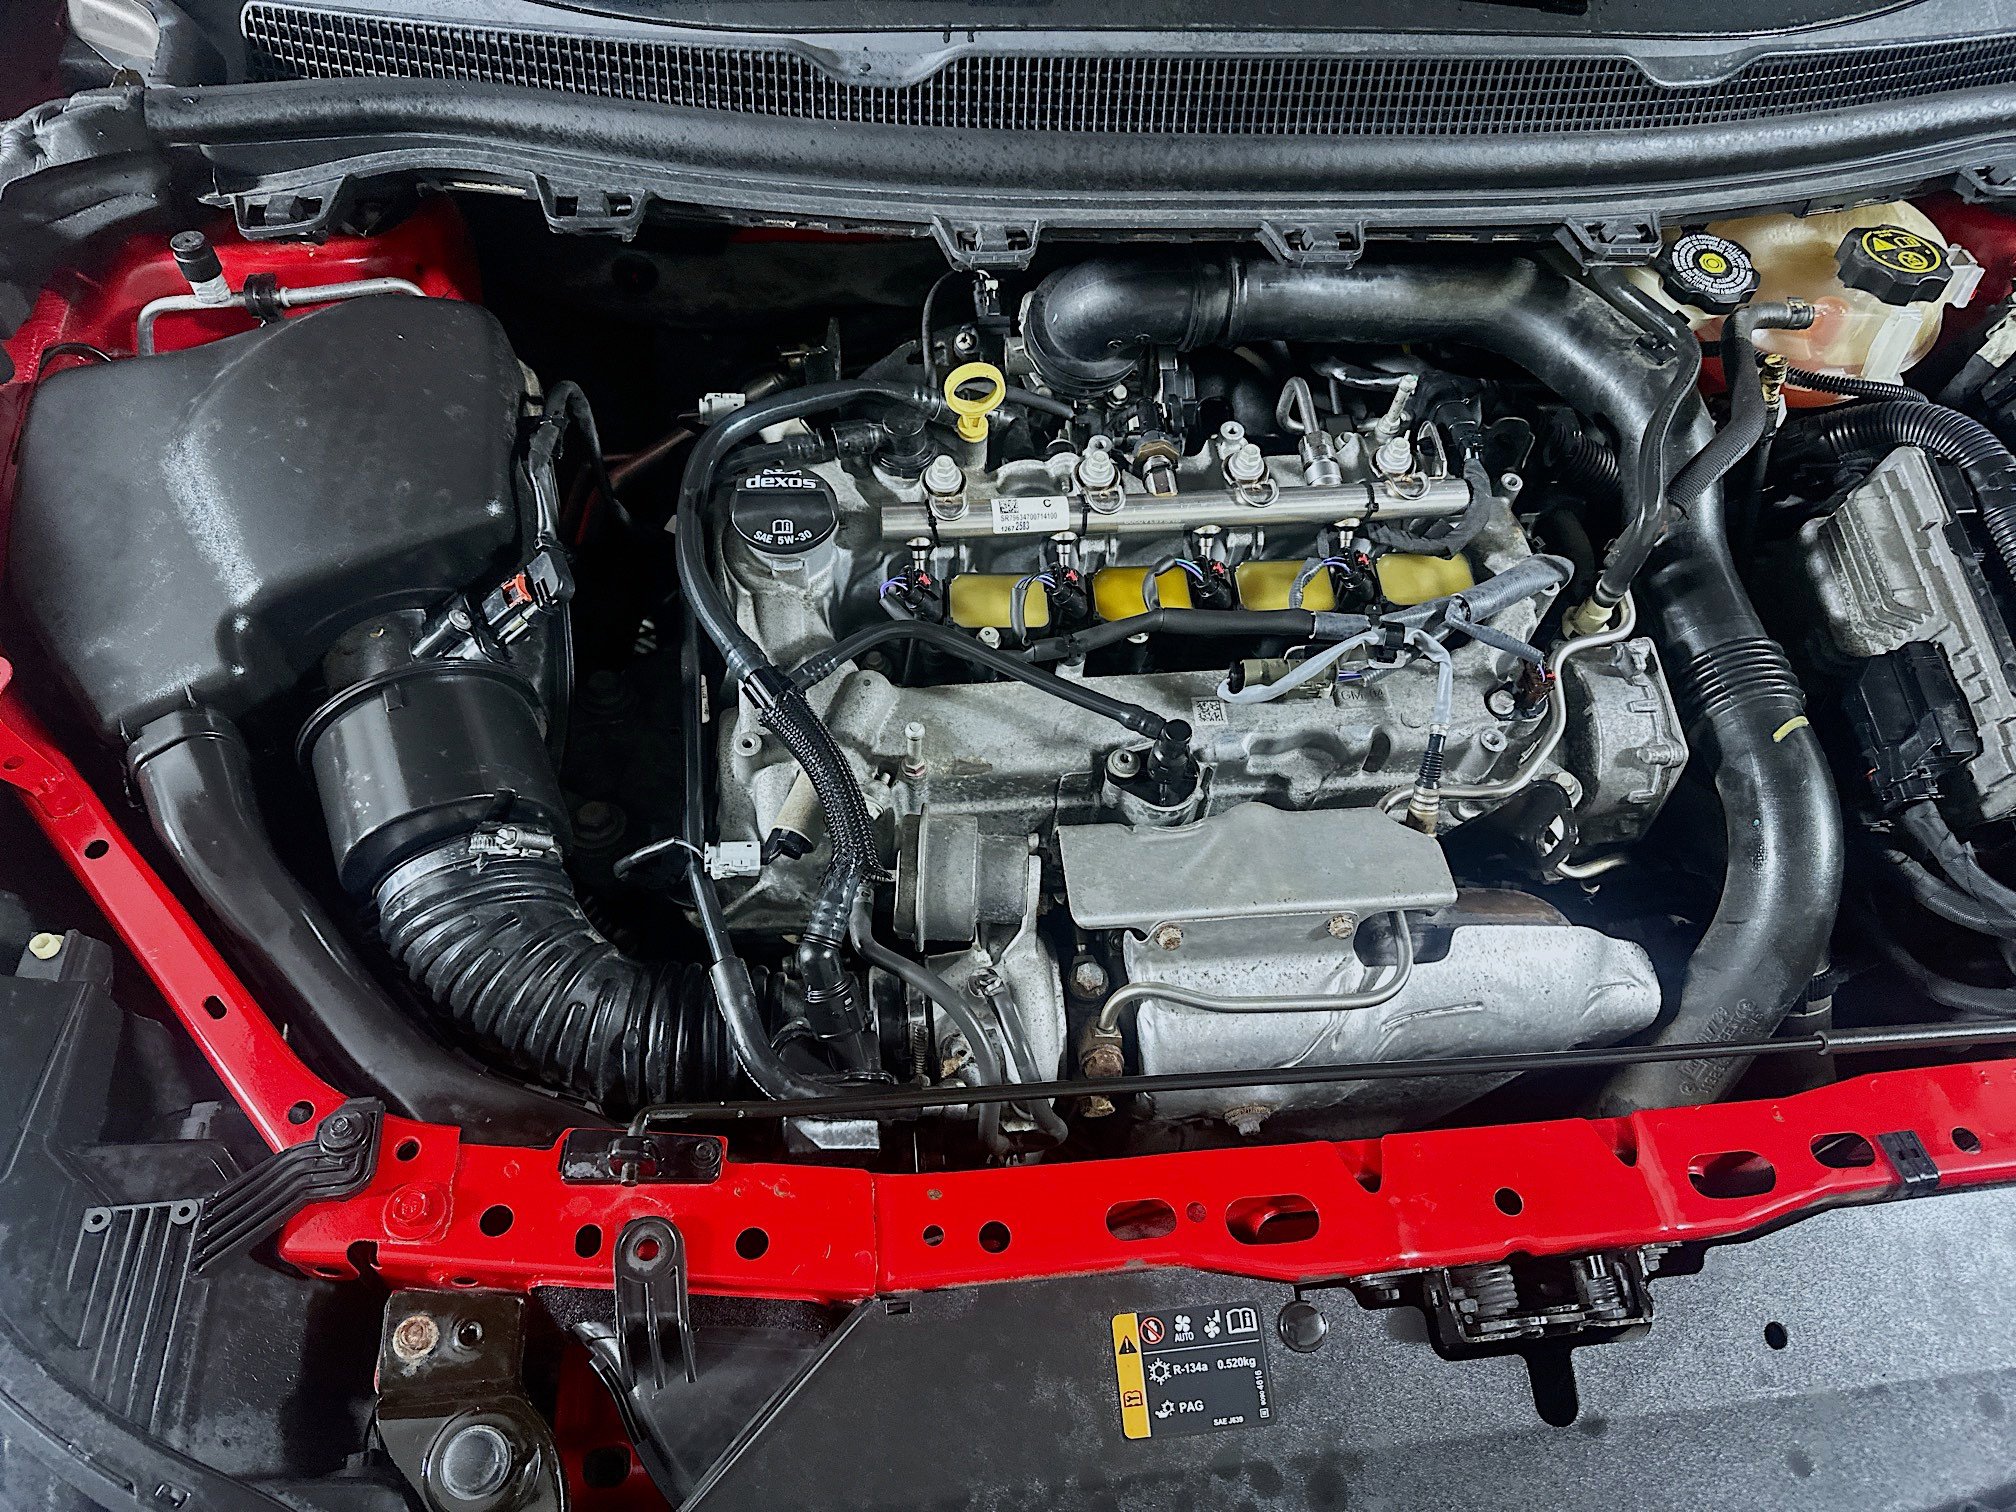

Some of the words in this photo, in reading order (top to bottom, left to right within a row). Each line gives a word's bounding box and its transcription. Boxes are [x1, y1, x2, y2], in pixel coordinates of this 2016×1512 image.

[746, 475, 817, 489] dexos
[1043, 499, 1052, 508] C
[753, 530, 774, 544] SAE
[777, 529, 813, 545] 5W-30
[1174, 1331, 1195, 1343] AUTO
[1172, 1361, 1209, 1375] R-134a
[1217, 1356, 1257, 1370] 0.520kg
[1178, 1400, 1205, 1413] PAG
[1213, 1417, 1228, 1426] SAE
